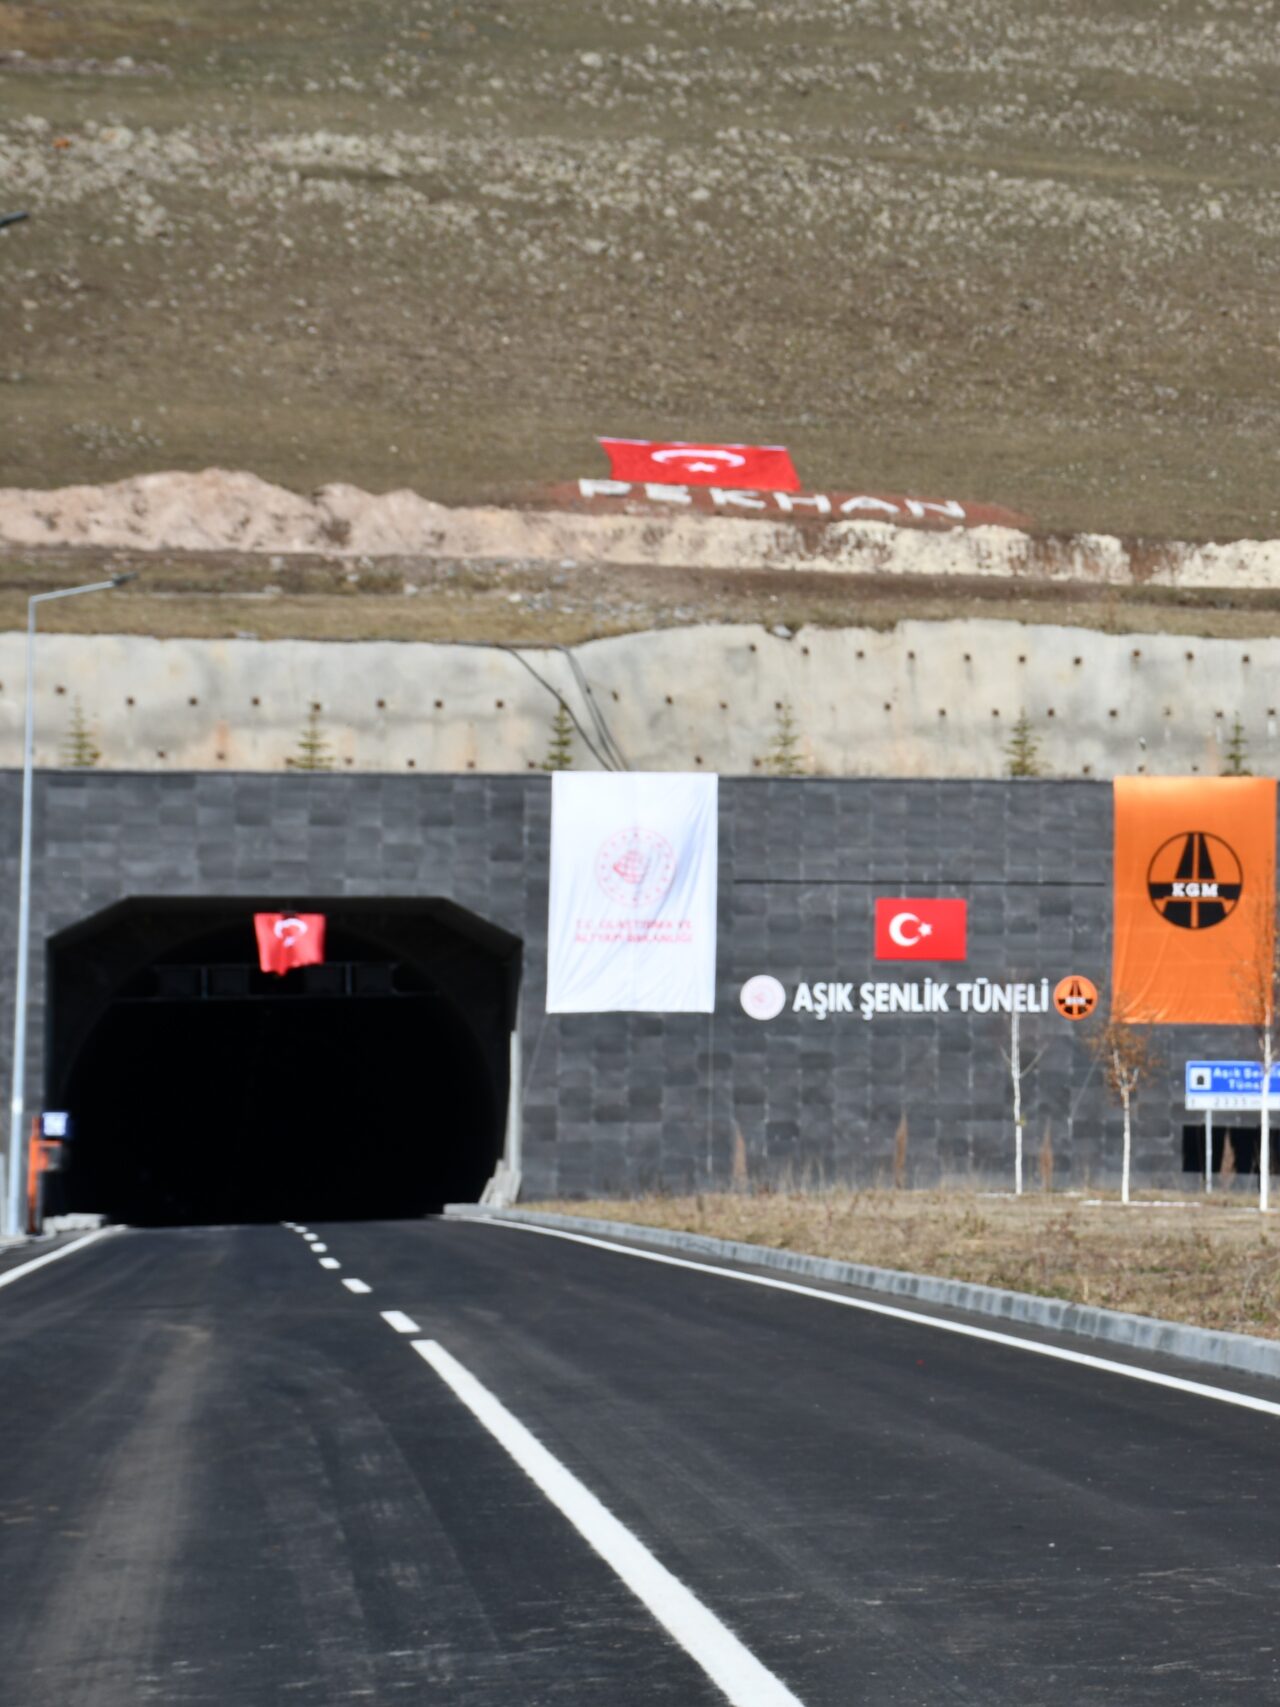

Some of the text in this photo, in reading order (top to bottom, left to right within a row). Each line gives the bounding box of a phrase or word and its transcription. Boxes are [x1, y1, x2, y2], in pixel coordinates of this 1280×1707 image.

[1172, 882, 1219, 897] KGM
[793, 977, 1050, 1020] AŞIK ŞENLİK TÜNELİ
